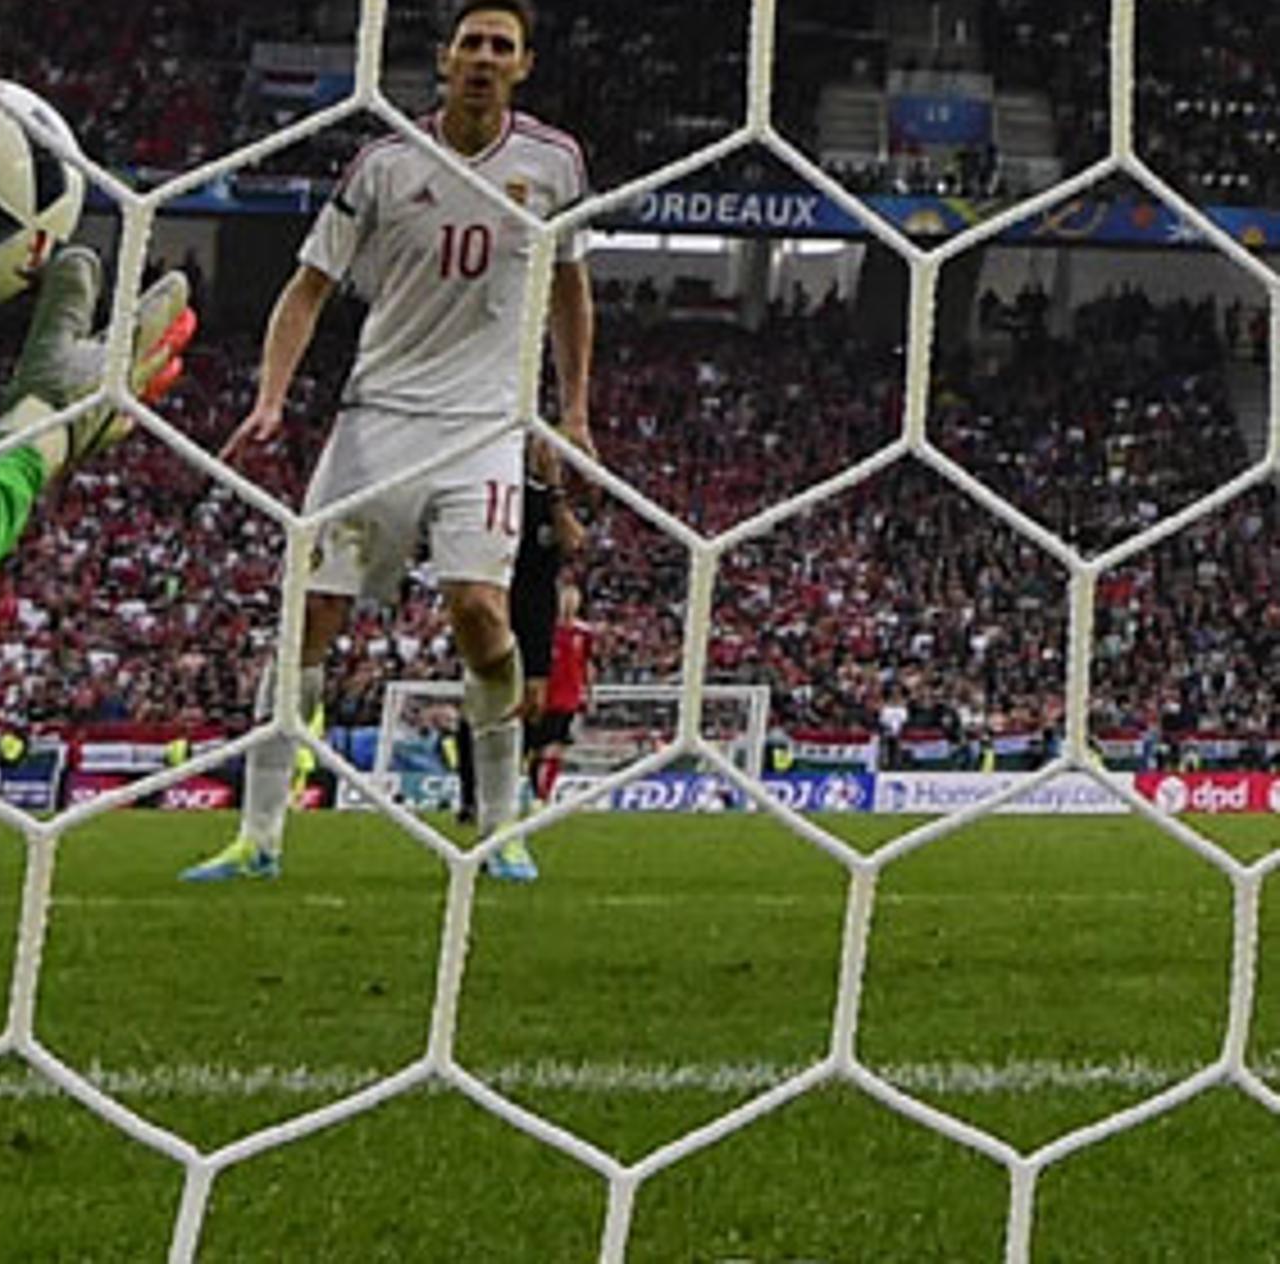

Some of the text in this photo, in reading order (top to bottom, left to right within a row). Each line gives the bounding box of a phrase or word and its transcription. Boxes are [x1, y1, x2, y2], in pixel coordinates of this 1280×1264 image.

[640, 190, 818, 228] ORDEAUX
[440, 223, 491, 280] 10
[1191, 778, 1249, 811] dpd
